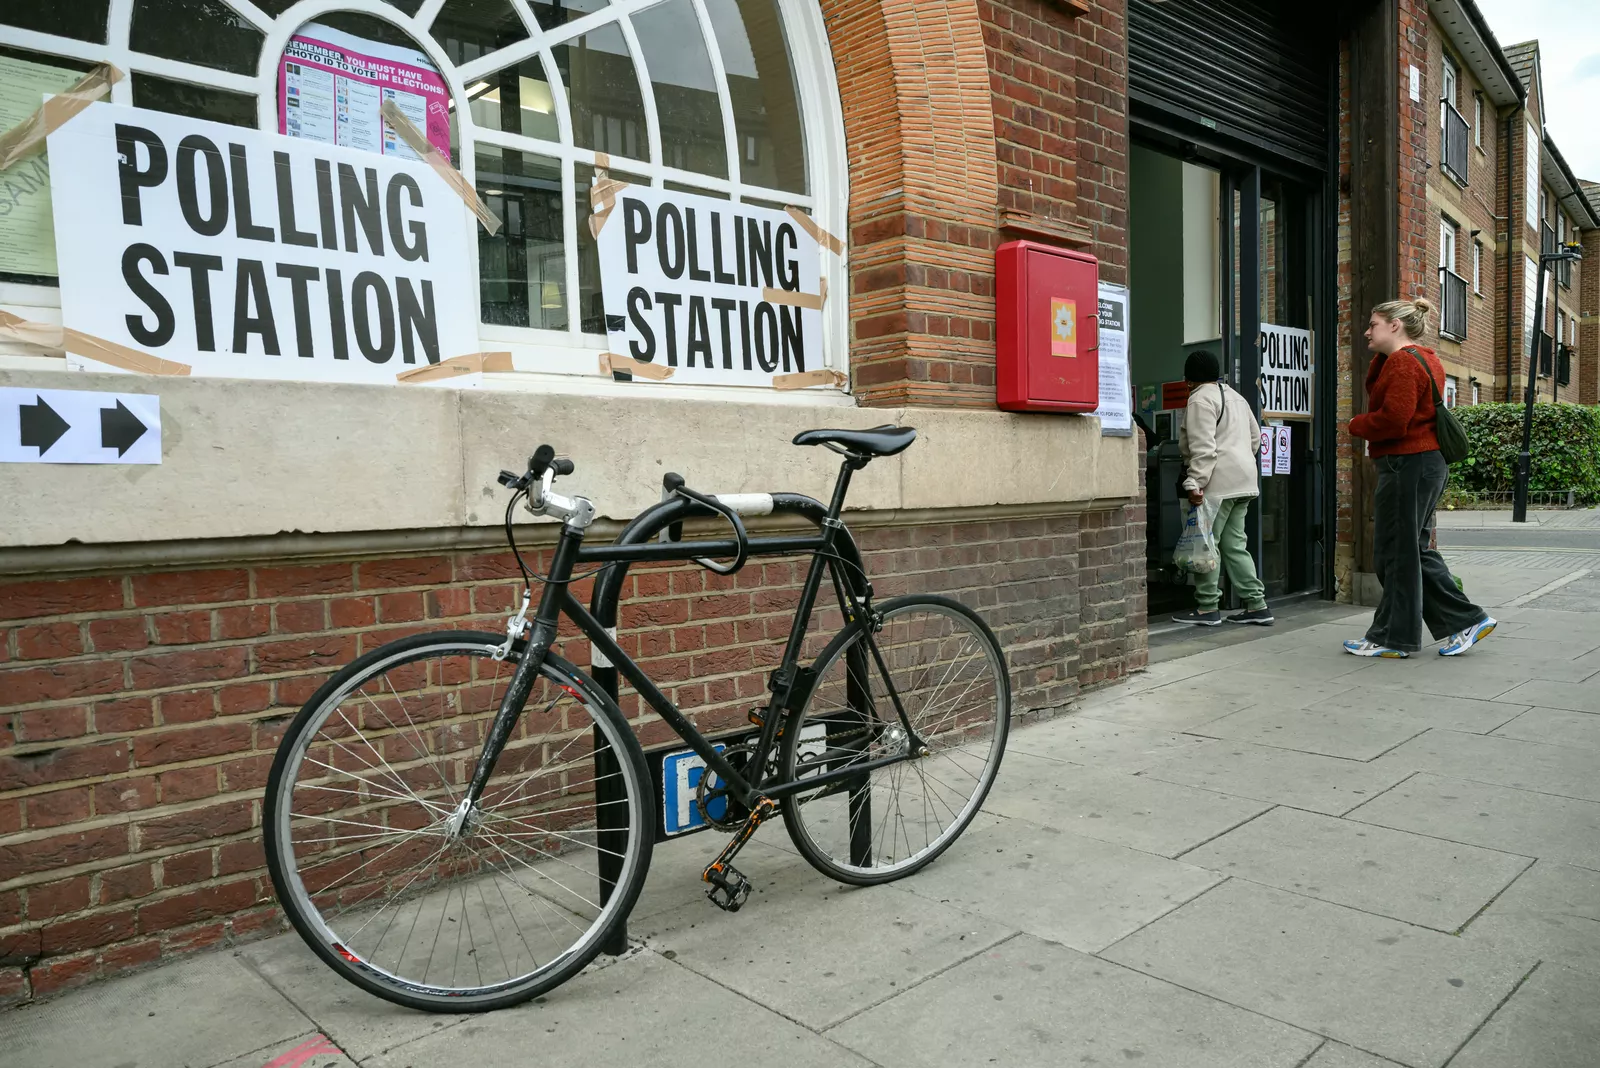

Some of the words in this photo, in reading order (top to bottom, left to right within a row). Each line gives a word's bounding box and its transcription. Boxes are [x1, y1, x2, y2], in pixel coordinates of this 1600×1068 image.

[285, 48, 321, 63] PHOTO
[324, 56, 334, 66] ID
[336, 60, 349, 70] TO
[351, 65, 376, 78] VOTE
[379, 71, 389, 82] IN
[392, 75, 444, 95] ELECTIONS!
[346, 55, 366, 68] YOU
[368, 61, 396, 75] MUST
[398, 68, 422, 81] HAVE
[115, 123, 429, 262] POLLING
[622, 197, 800, 292] POLLING
[121, 243, 441, 365] STATION
[1105, 319, 1120, 328] STATION
[627, 286, 805, 373] STATION
[1261, 332, 1308, 371] POLLING
[1261, 373, 1308, 411] STATION
